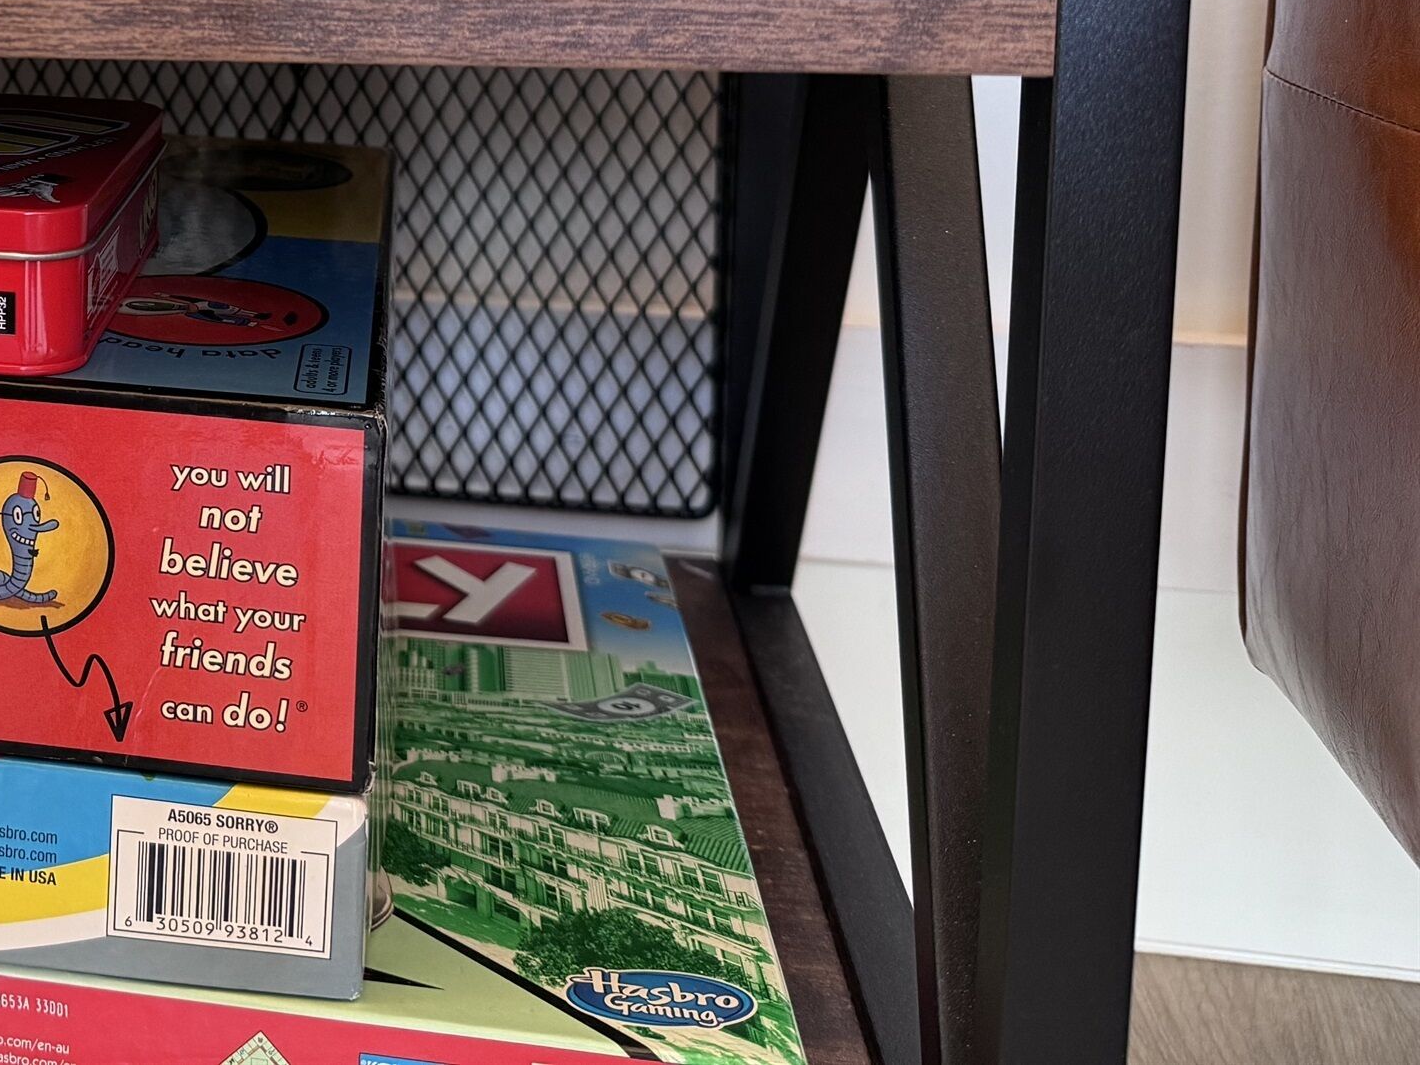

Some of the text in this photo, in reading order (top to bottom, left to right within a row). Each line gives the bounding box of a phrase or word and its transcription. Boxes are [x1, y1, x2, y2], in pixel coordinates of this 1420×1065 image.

[99, 336, 282, 359] data head
[170, 463, 292, 495] you will
[198, 504, 263, 534] not
[158, 537, 300, 588] believe
[148, 591, 307, 634] what your
[160, 631, 293, 681] friends
[160, 698, 214, 725] can
[167, 807, 212, 828] A5065
[157, 827, 288, 855] PROOF OF PURCHASE
[10, 866, 25, 882] IN
[28, 868, 57, 886] USA
[124, 915, 313, 947] 6 30509 93812 4
[578, 969, 740, 1009] Hasbro
[603, 992, 719, 1026] Gaming
